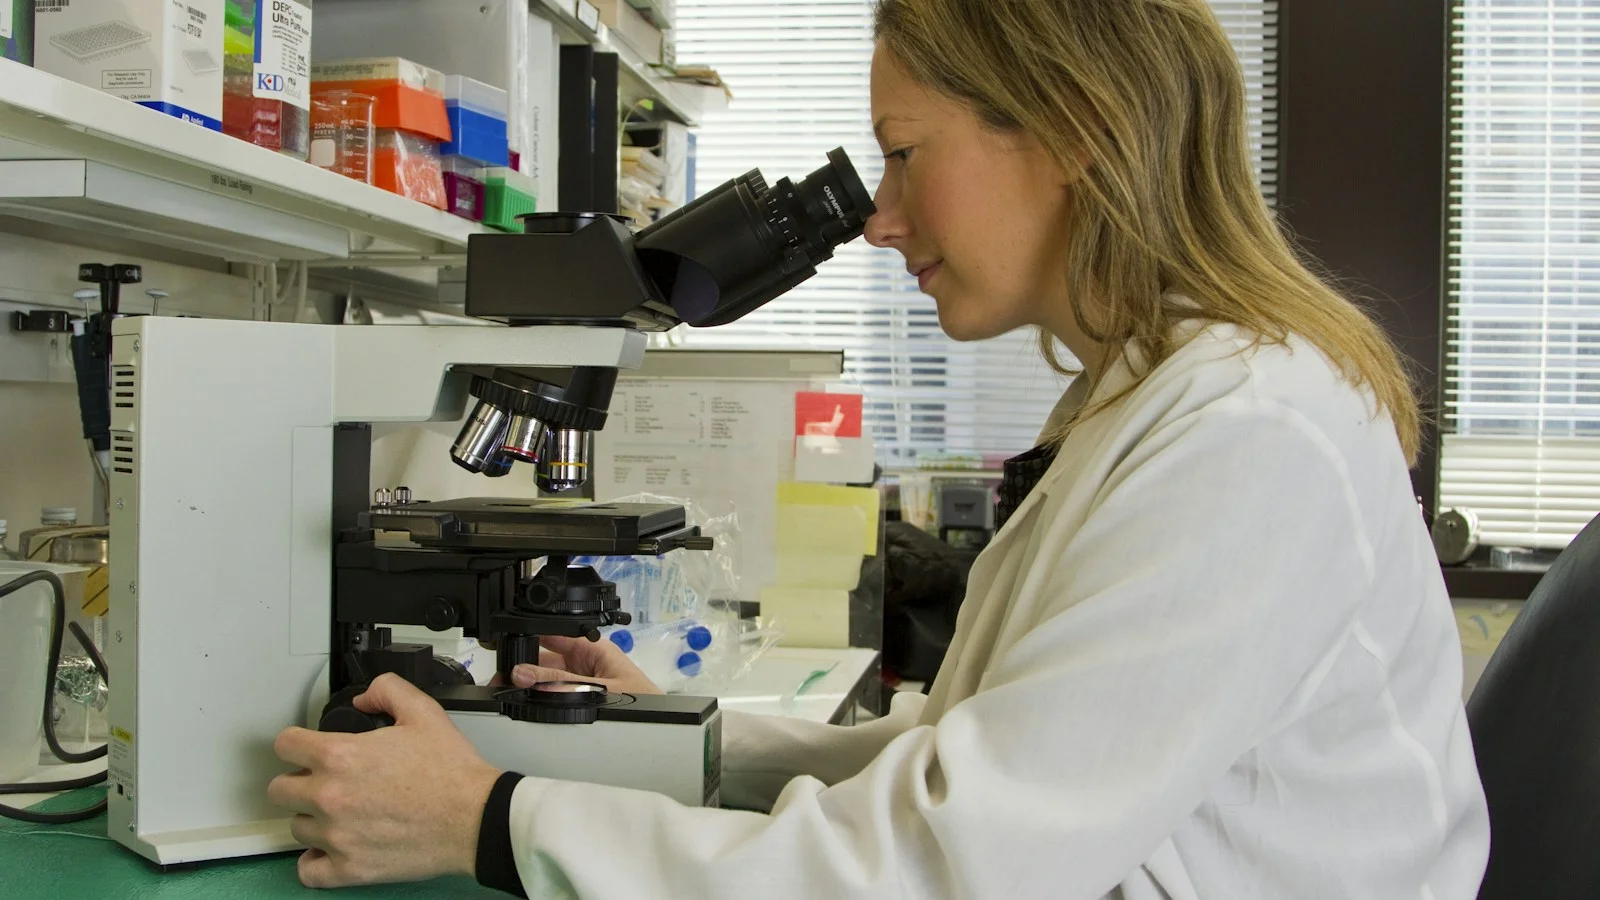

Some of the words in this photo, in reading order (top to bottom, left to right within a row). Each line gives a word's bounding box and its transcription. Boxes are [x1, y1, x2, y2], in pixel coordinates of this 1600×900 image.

[273, 1, 292, 15] DEPC
[272, 13, 289, 26] Ultra
[290, 18, 301, 31] Pure
[824, 186, 844, 218] OLYMPUS
[48, 318, 55, 329] 3
